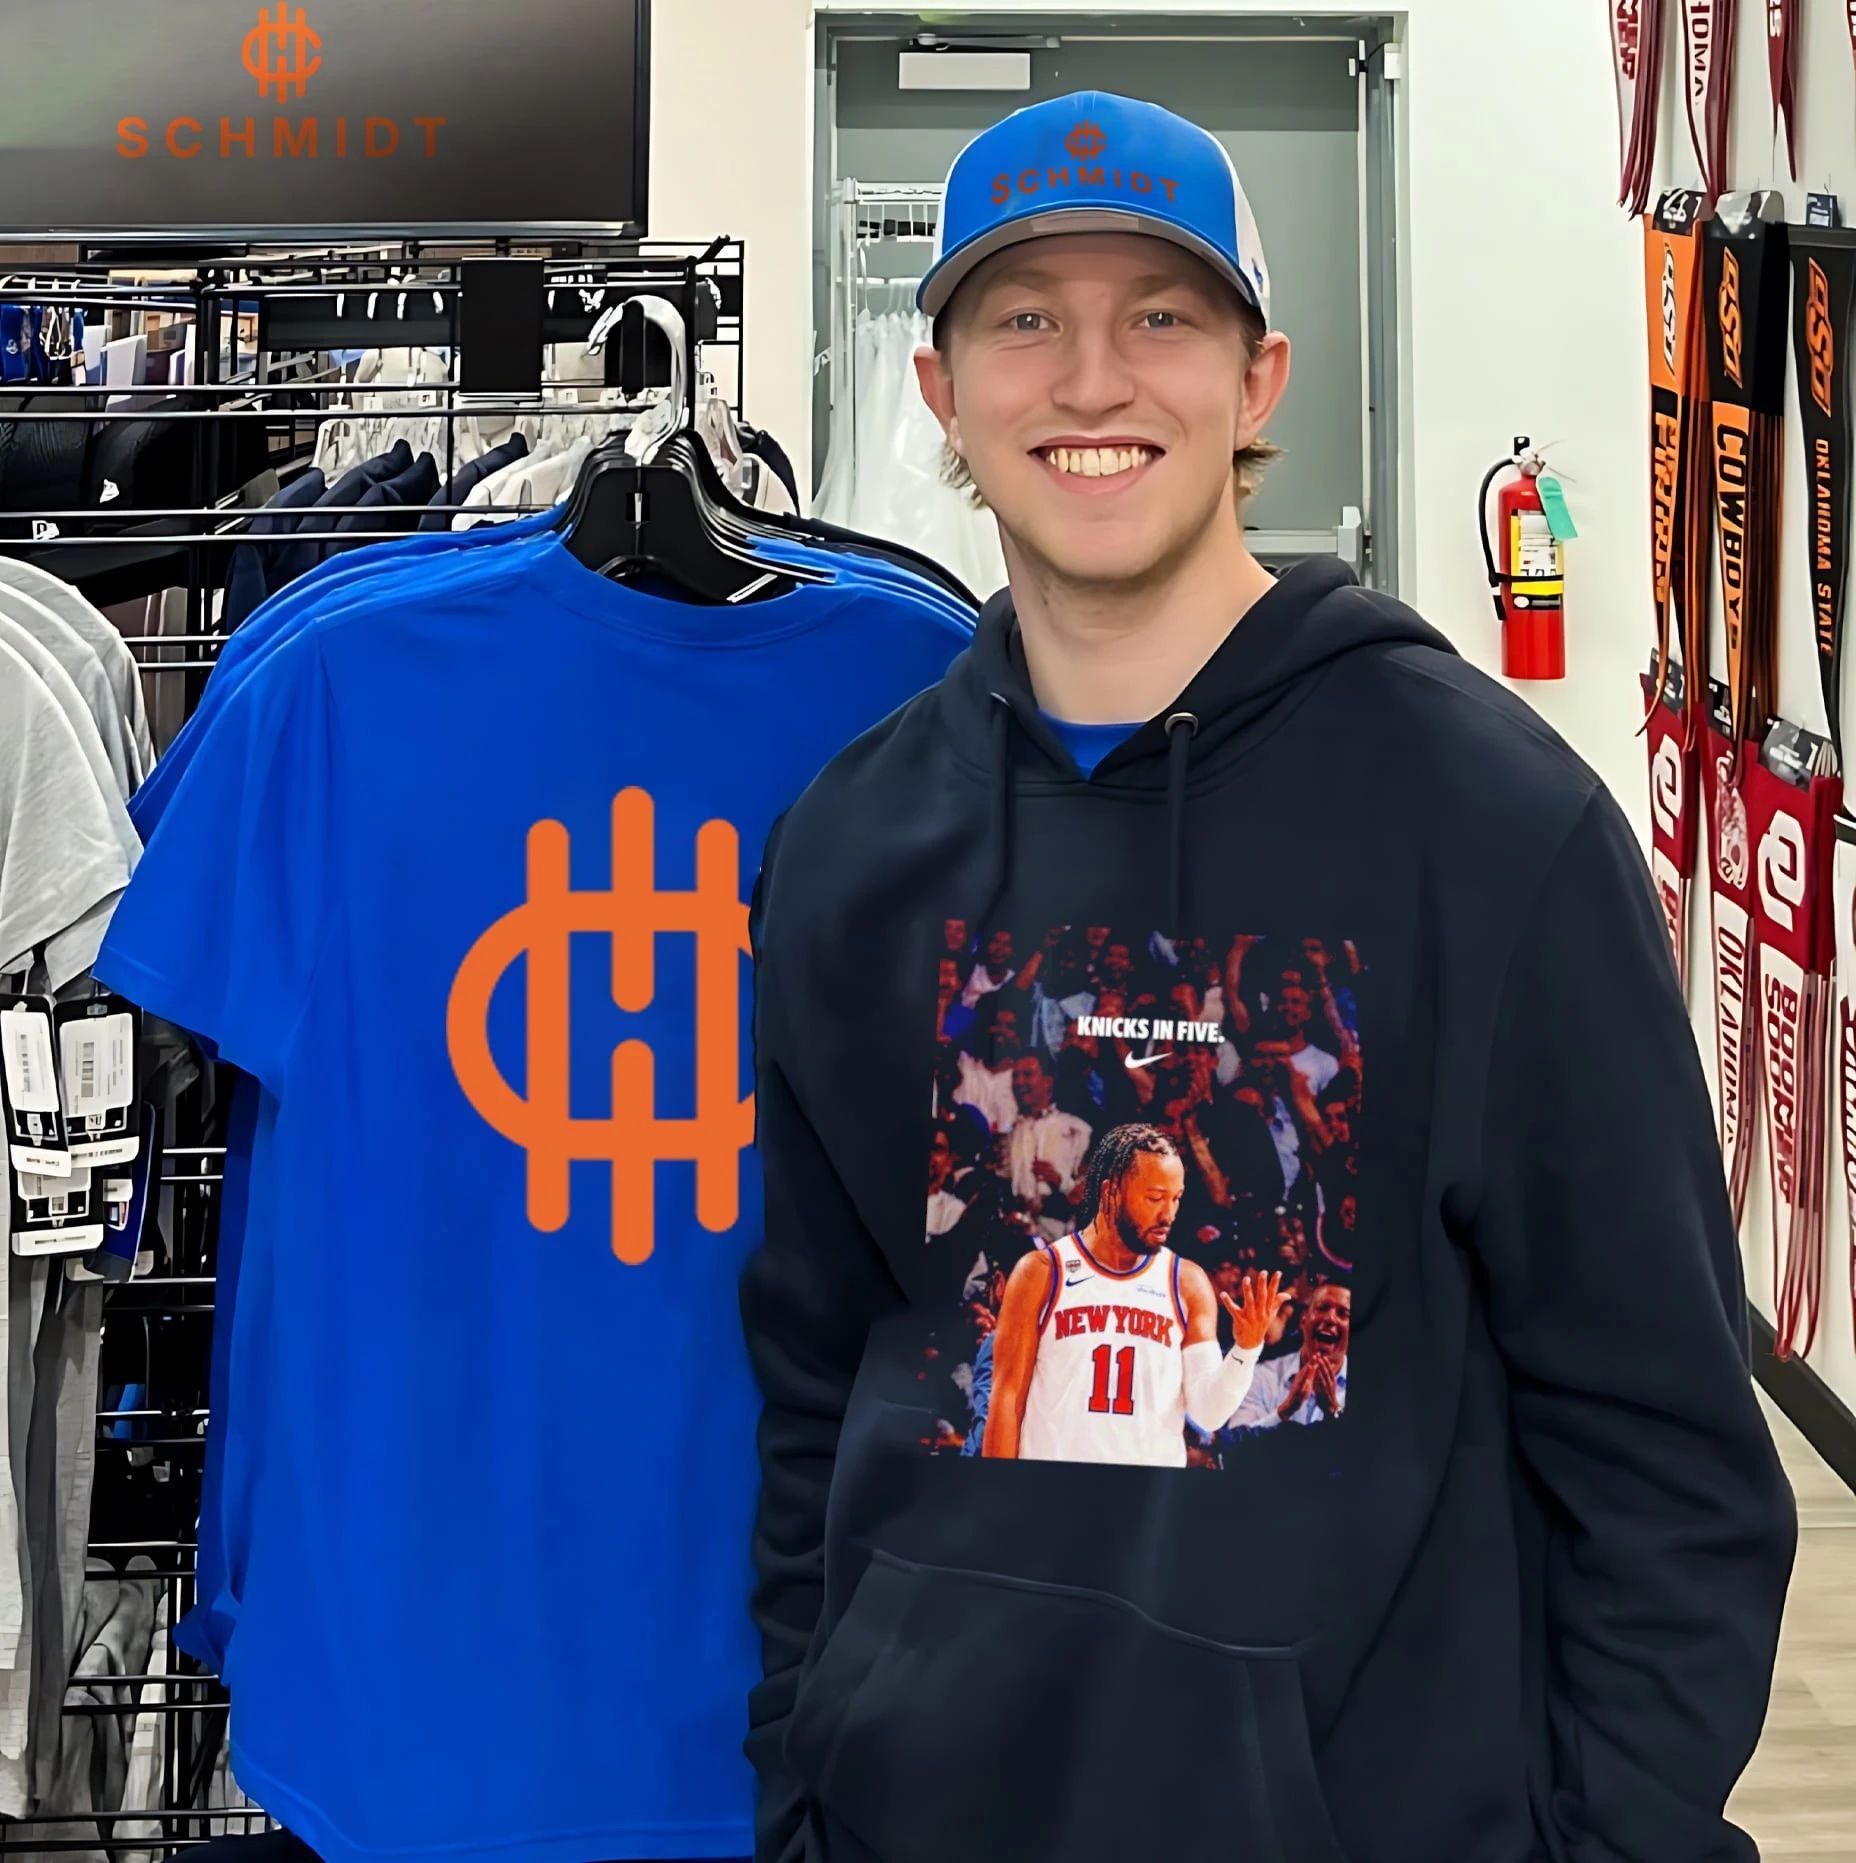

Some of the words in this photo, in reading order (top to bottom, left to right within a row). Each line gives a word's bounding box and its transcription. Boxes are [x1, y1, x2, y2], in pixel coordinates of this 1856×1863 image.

[116, 116, 448, 159] SCHMIDT
[991, 166, 1180, 205] SCHMIDT
[1815, 438, 1832, 571] OKLAHOMA
[1077, 1015, 1149, 1041] KNICKS
[1152, 1019, 1175, 1042] IN
[1176, 1020, 1225, 1044] FIVE.
[1054, 1304, 1110, 1341] NEW
[1112, 1306, 1173, 1347] YORK
[1088, 1344, 1136, 1416] 11
